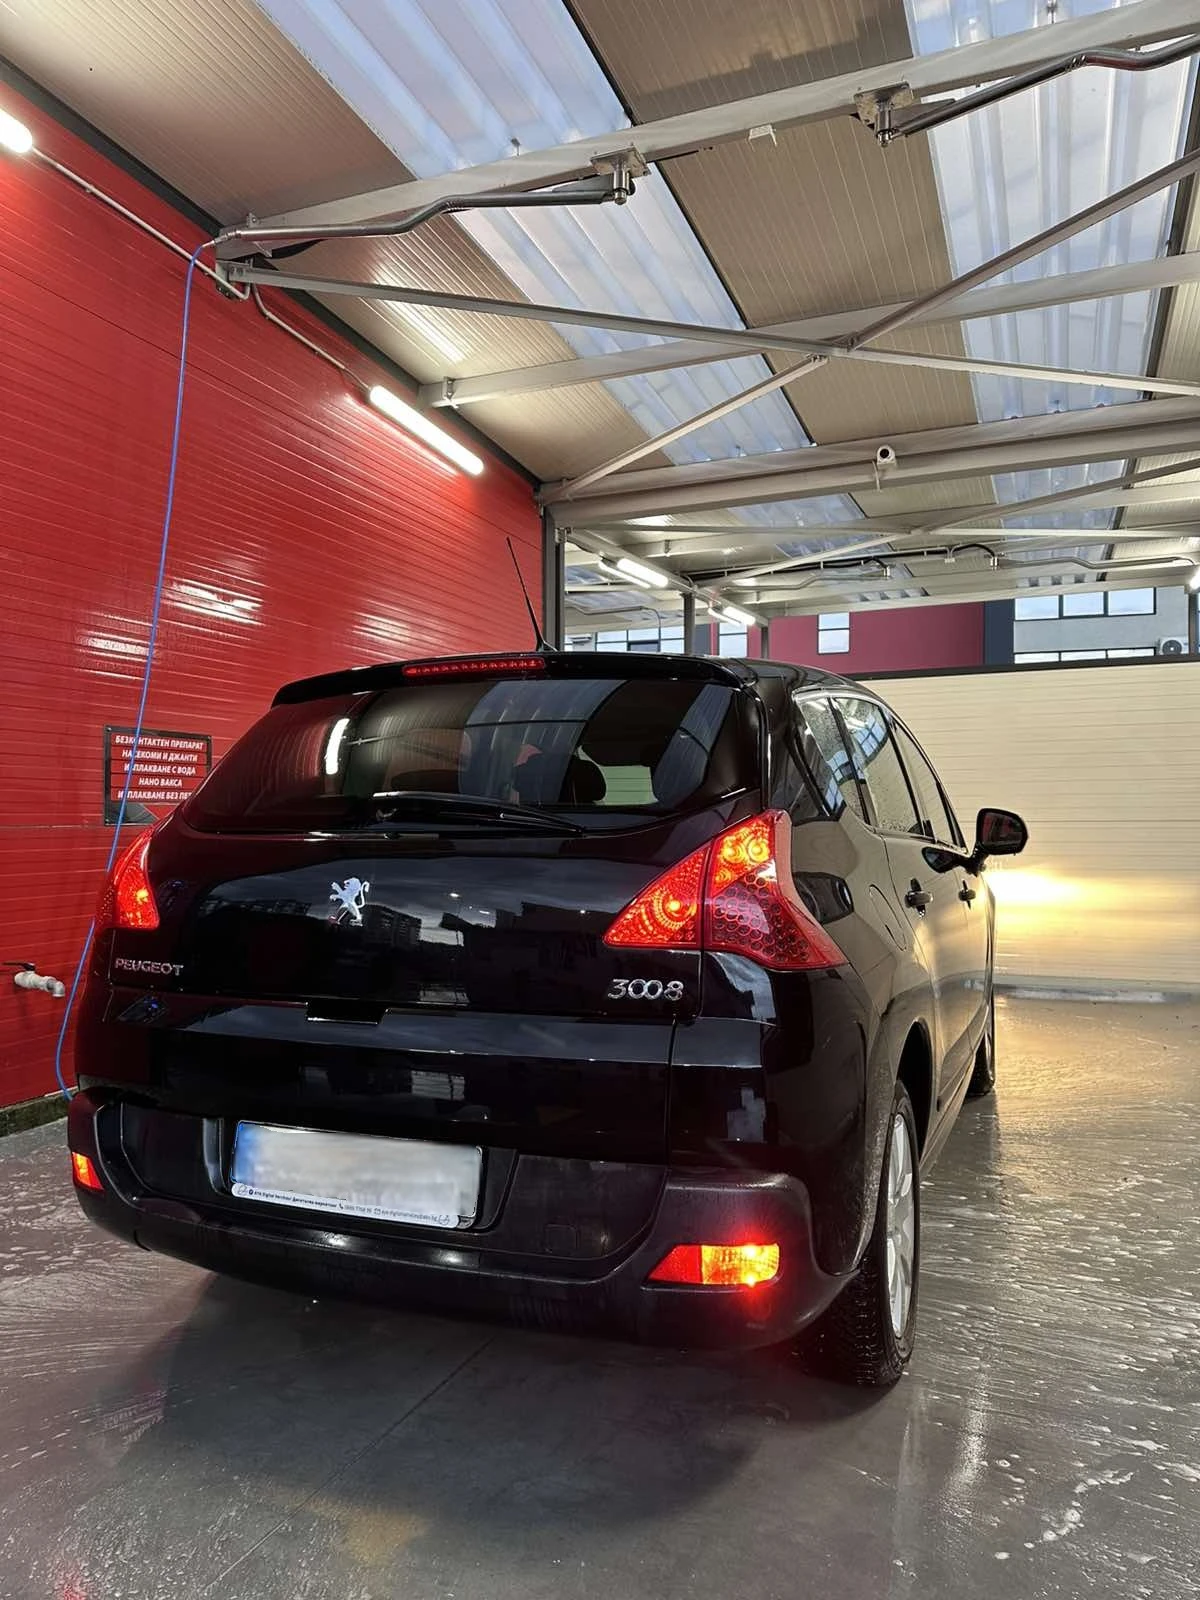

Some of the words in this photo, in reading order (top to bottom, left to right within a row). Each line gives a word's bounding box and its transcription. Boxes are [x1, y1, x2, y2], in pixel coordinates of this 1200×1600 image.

[115, 735, 170, 747] БЕЗКНТАКТЕН
[170, 740, 203, 750] ПРЕПАРАТ
[162, 752, 167, 760] И
[168, 753, 198, 762] ДЖАНТИ
[124, 763, 171, 774] ИПЛАКВАНЕ
[177, 766, 196, 775] ВОДА
[138, 777, 159, 786] НАНО
[159, 778, 183, 787] ВАКСА
[117, 790, 165, 799] ИПЛАКВАНЕ
[166, 791, 178, 800] БЕЗ
[179, 792, 192, 800] ПЕТ
[115, 957, 184, 976] PEUGEOT
[607, 978, 684, 1001] 3008
